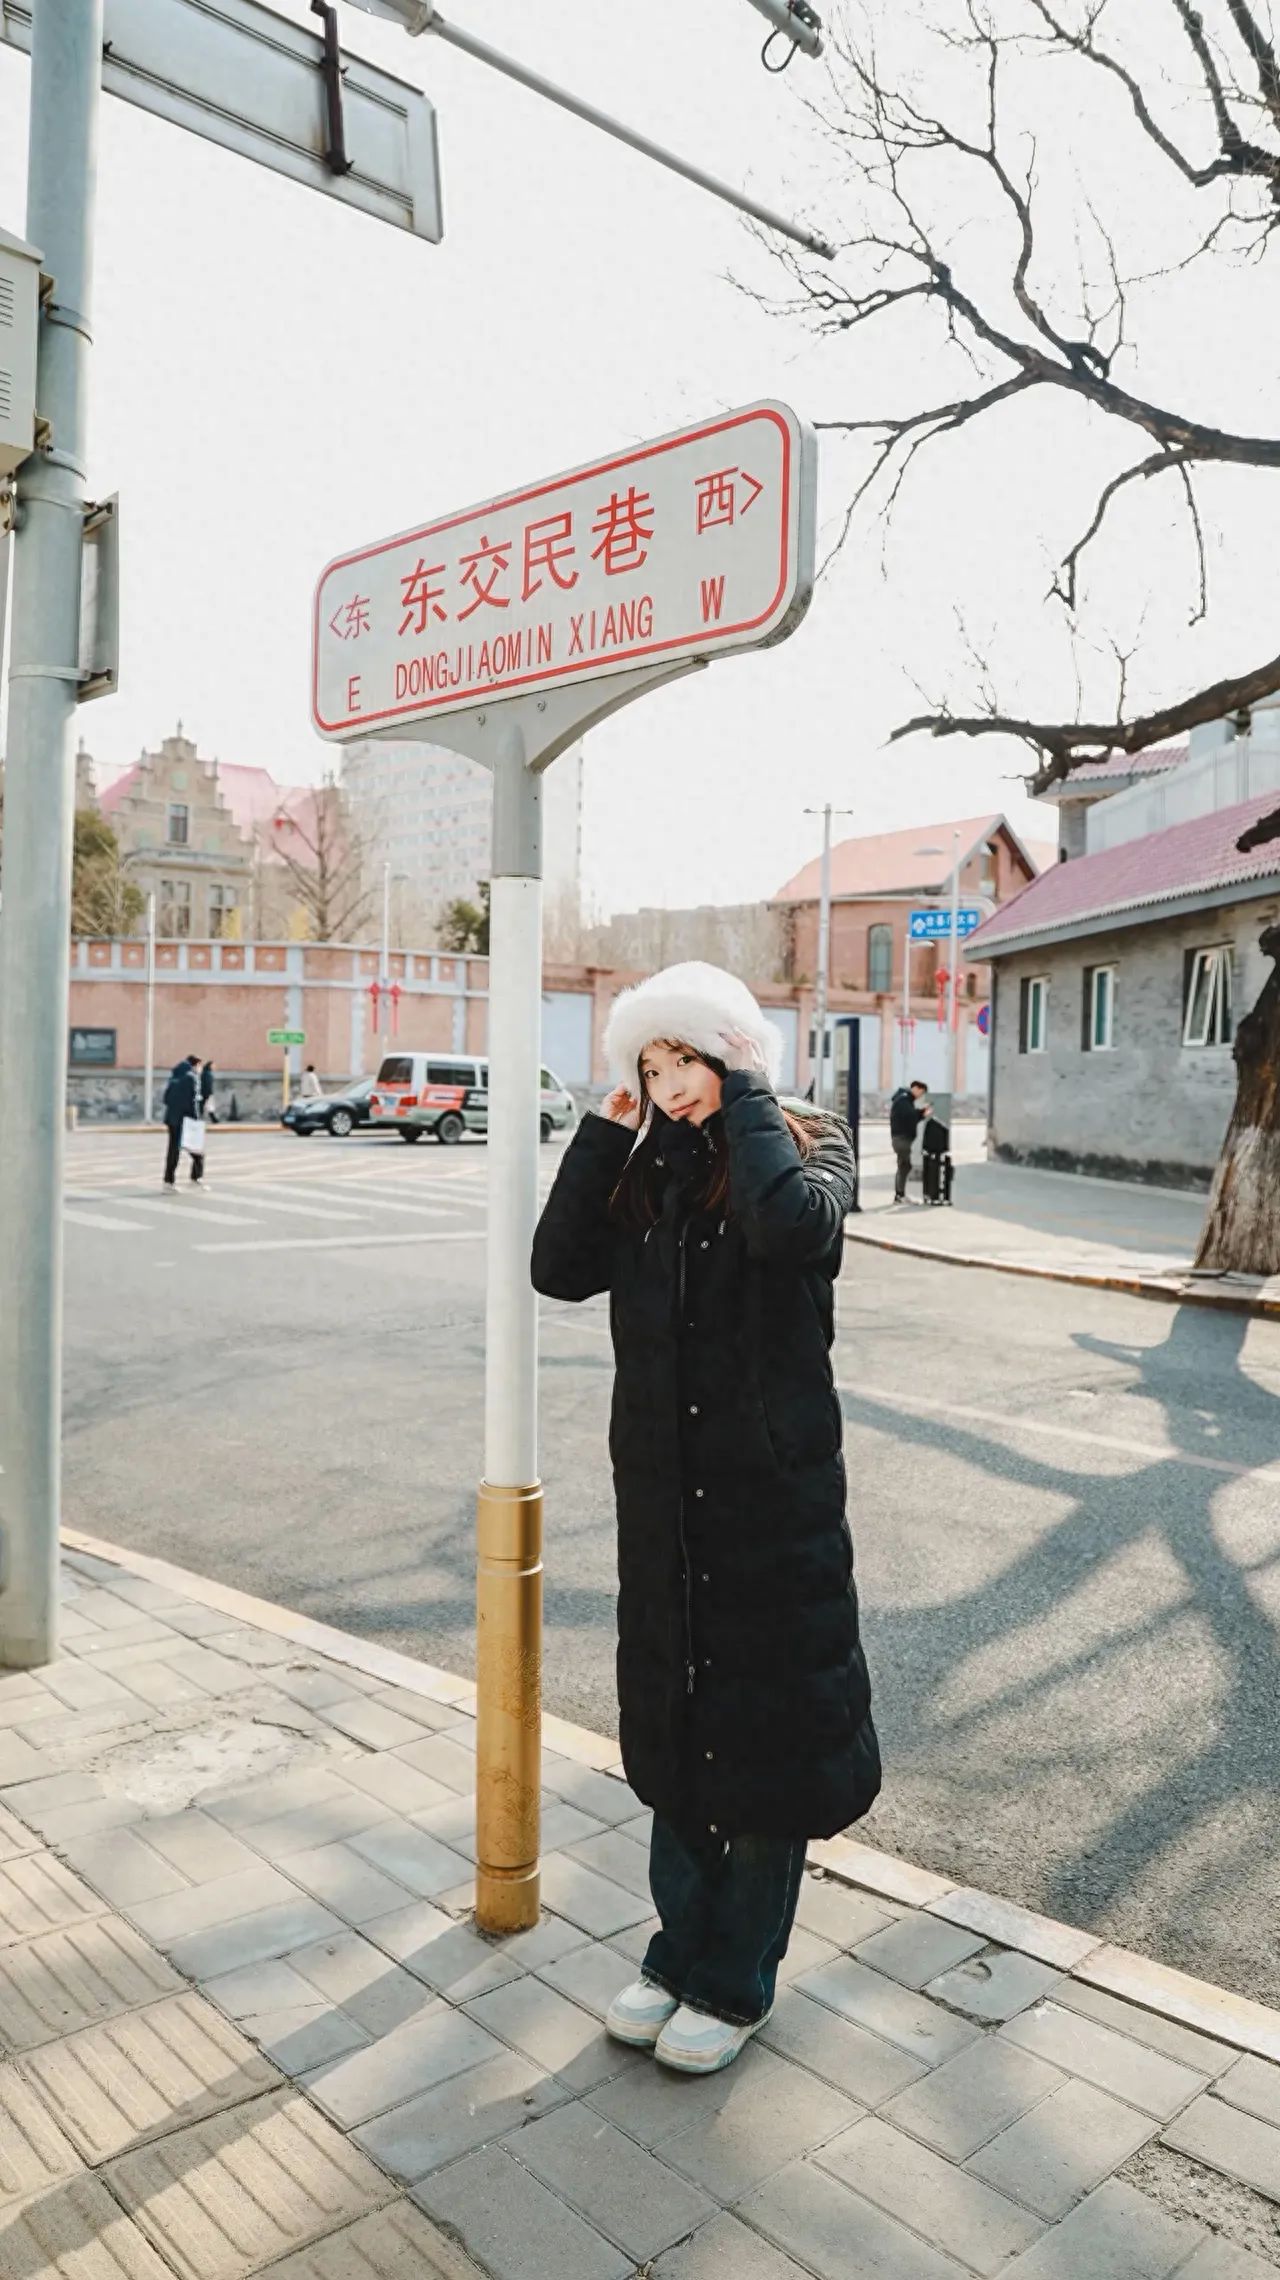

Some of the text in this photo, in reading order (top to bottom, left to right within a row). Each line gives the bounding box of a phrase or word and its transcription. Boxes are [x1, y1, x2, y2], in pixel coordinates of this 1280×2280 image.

[693, 466, 740, 535] 西
[397, 487, 655, 635] 东交民巷
[346, 595, 370, 639] 东
[700, 575, 726, 624] W
[395, 595, 655, 699] DONGJIAOMIN XIANG
[348, 676, 361, 712] E
